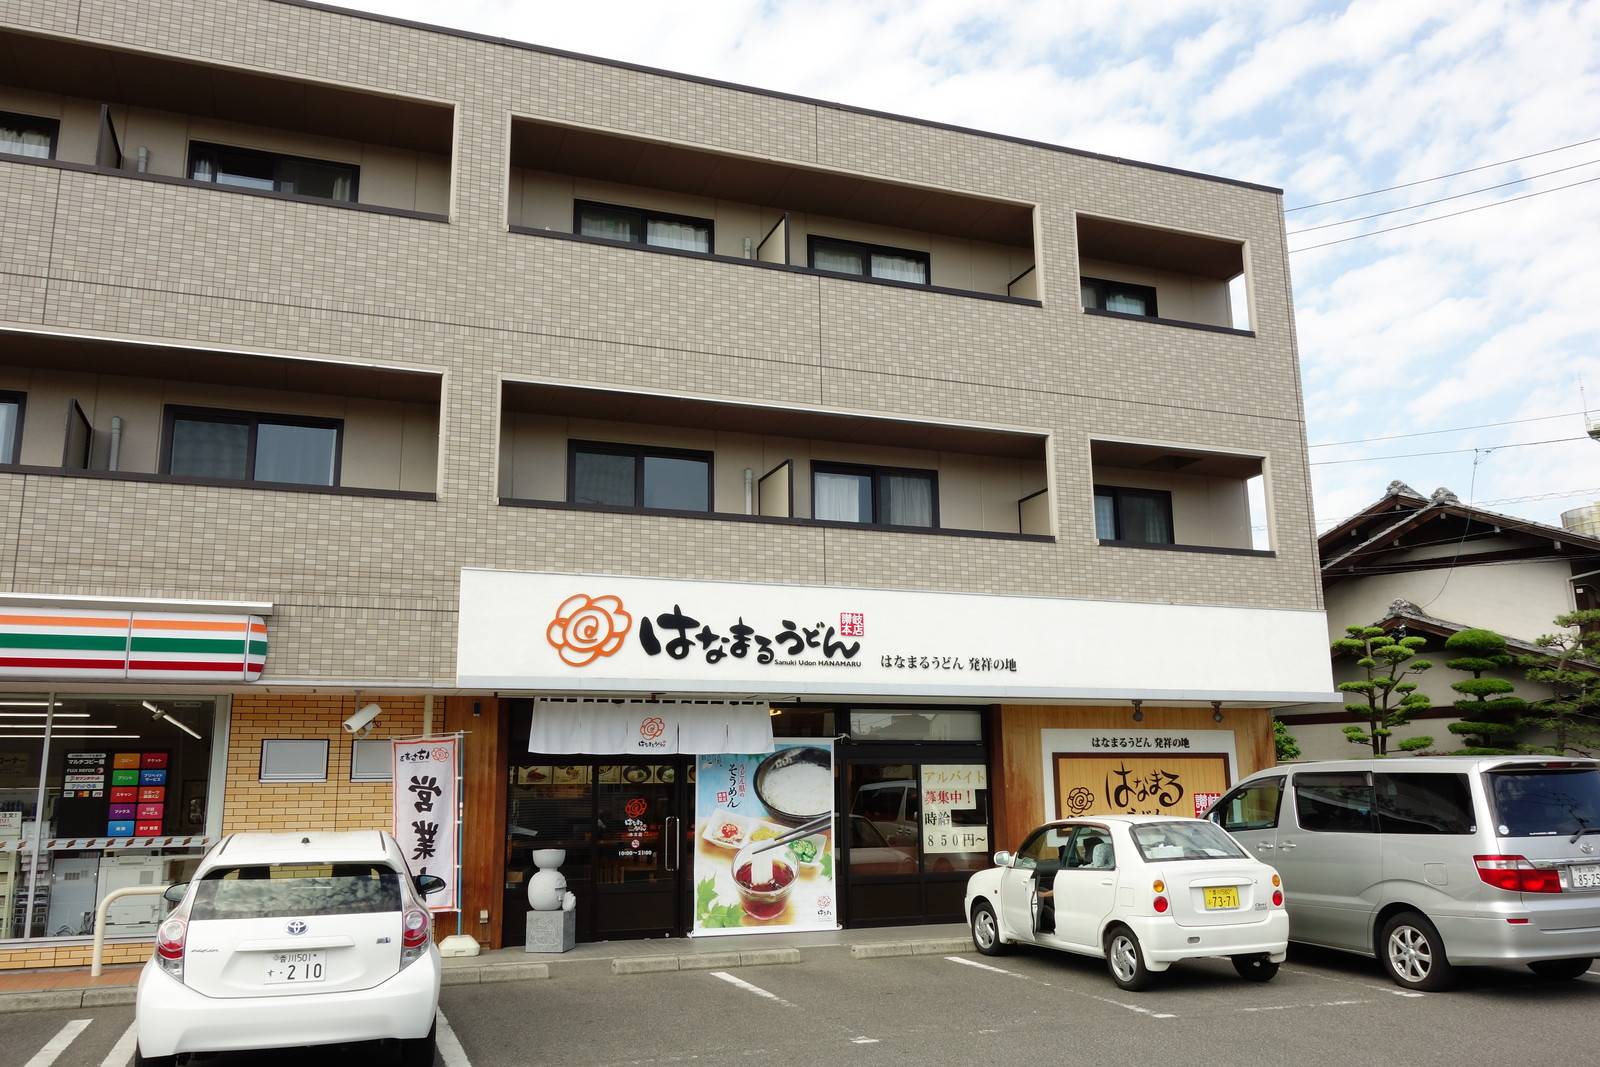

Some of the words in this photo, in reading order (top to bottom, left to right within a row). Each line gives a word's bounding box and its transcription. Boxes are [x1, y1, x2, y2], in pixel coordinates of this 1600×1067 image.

[639, 604, 861, 665] はなまるうどん
[774, 658, 797, 666] Sanuki
[798, 659, 817, 667] Udon
[880, 655, 964, 669] はなまるうどん
[969, 657, 1017, 672] 発祥の地
[1092, 737, 1151, 748] はなまるうどん
[1155, 738, 1190, 748] 発祥の地
[923, 770, 985, 783] アルバイト
[727, 763, 740, 808] そうめん
[1105, 761, 1184, 810] はなまる
[925, 811, 950, 825] 時給
